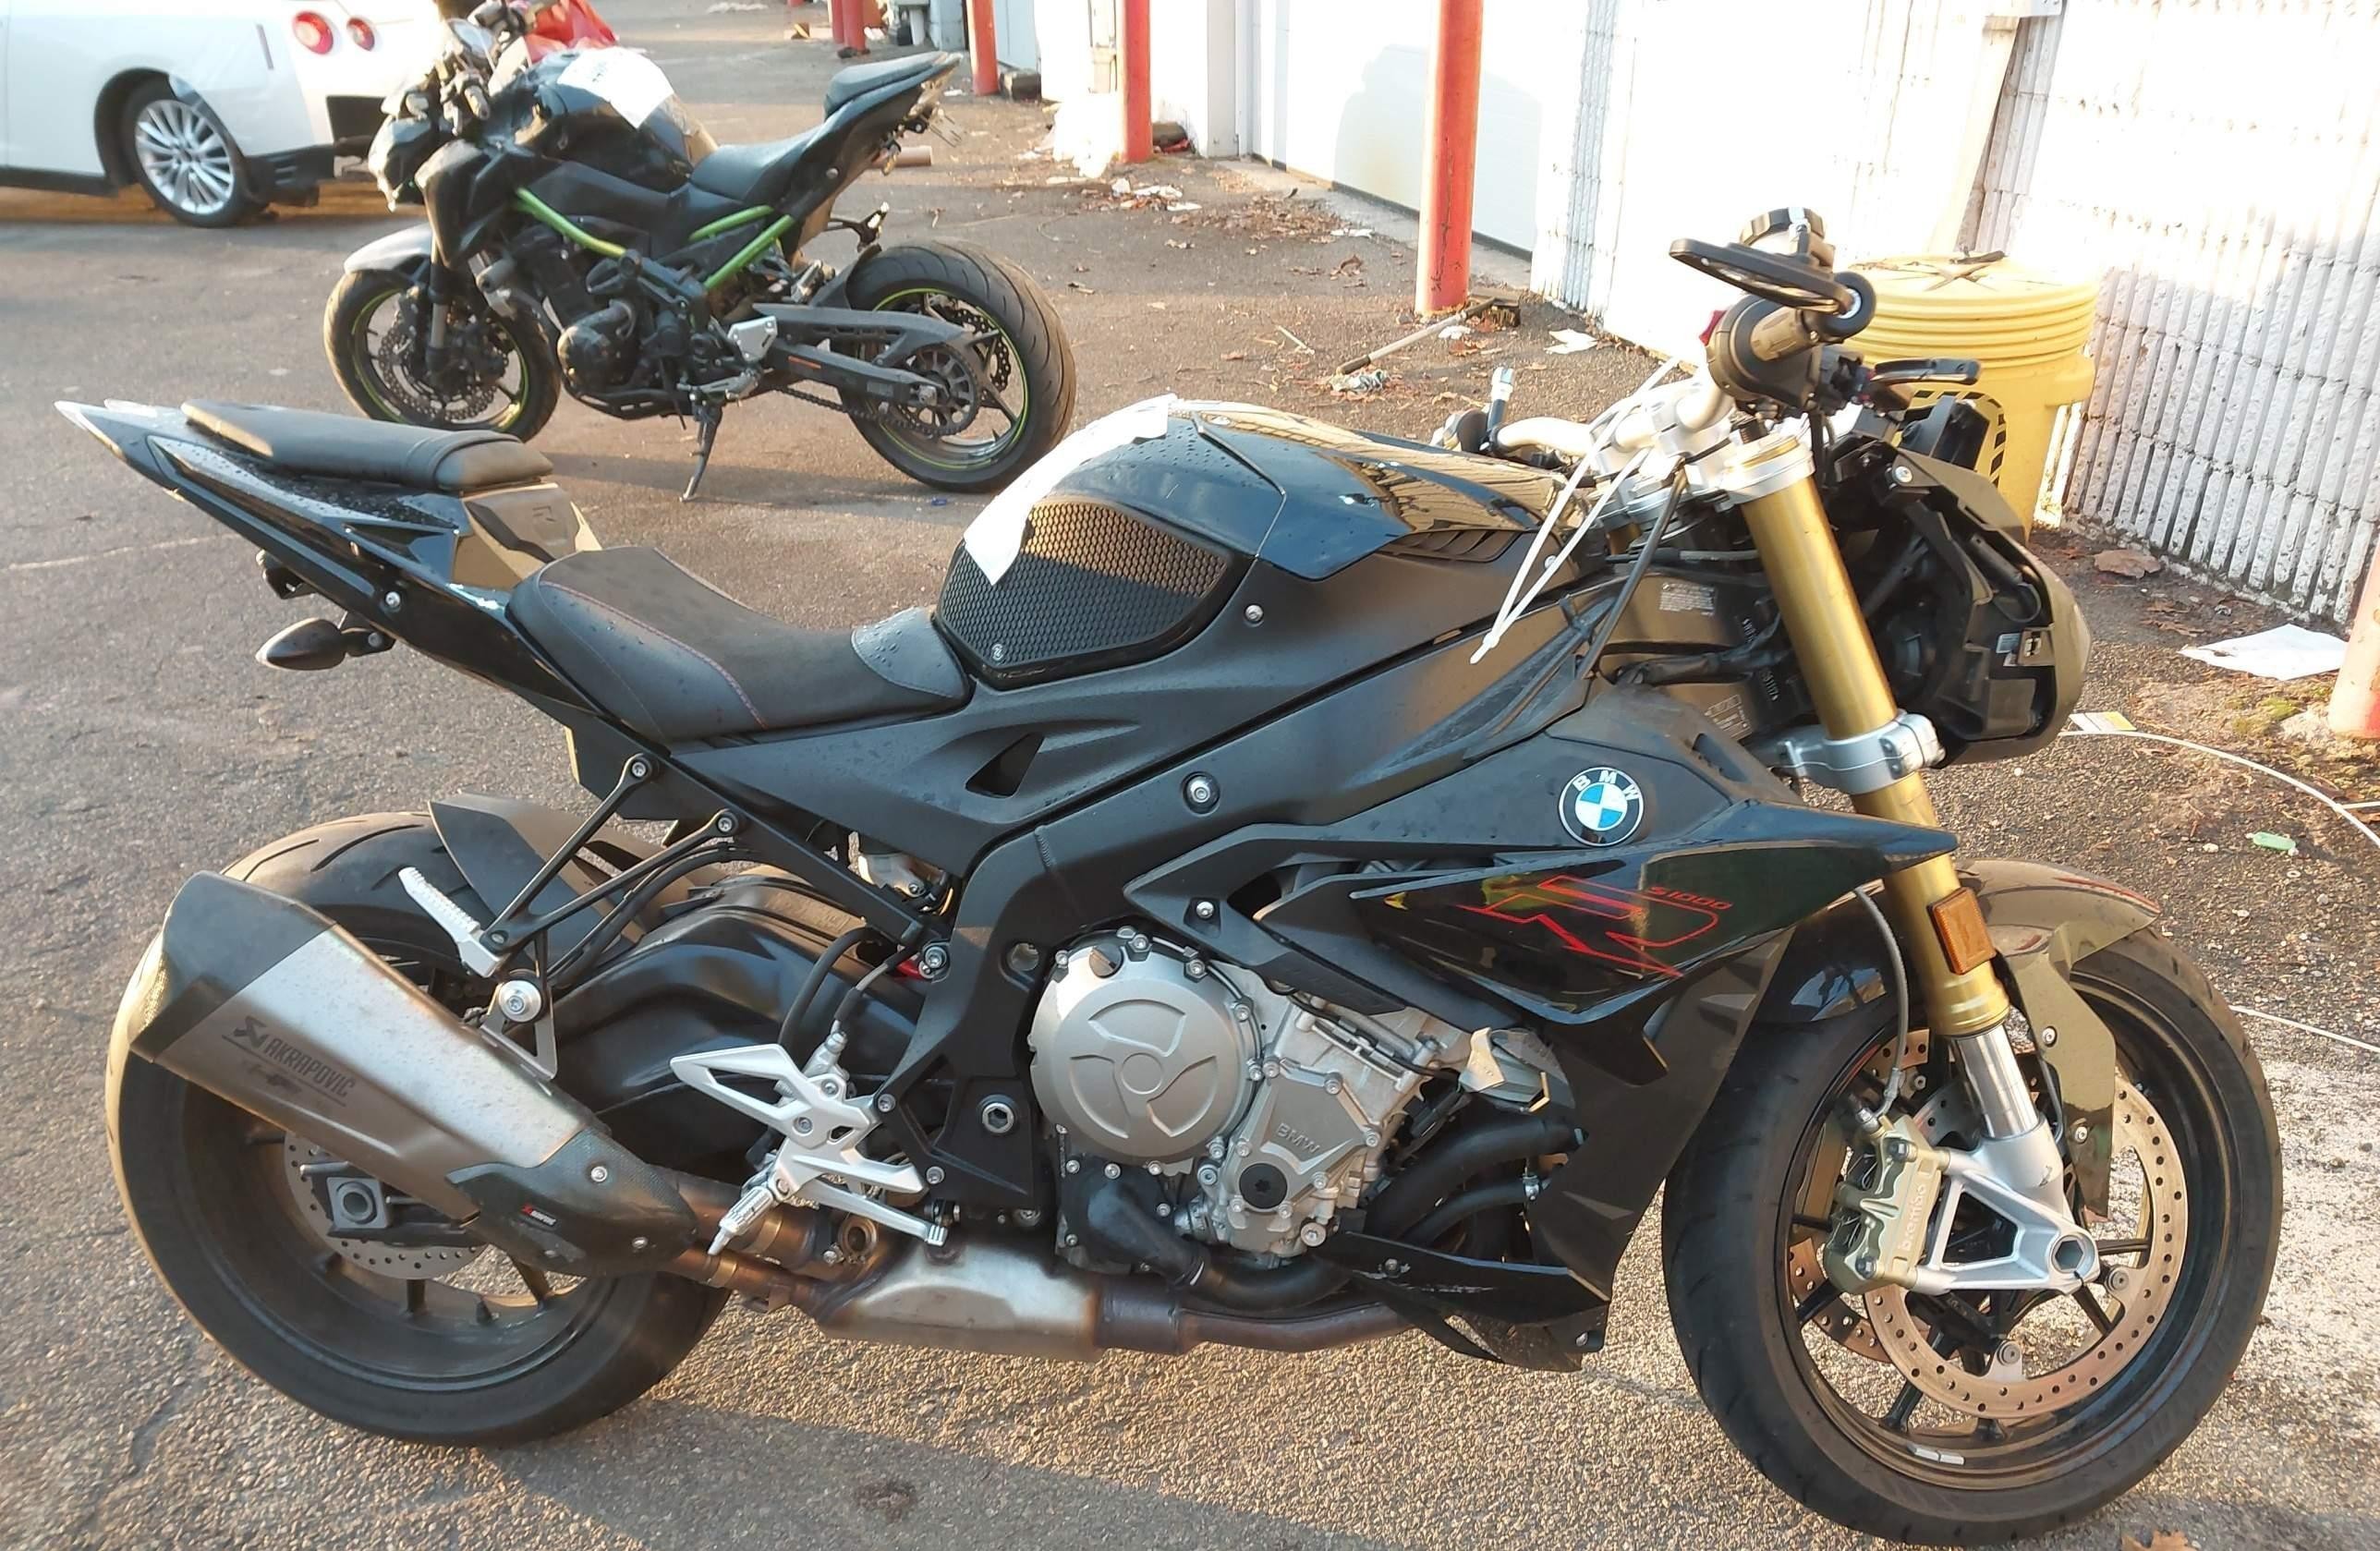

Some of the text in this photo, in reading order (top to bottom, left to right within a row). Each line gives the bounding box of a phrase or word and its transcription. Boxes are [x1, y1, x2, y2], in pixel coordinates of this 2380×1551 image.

[1572, 769, 1640, 801] BMW
[1647, 886, 1732, 910] S1000
[1277, 1122, 1320, 1153] BMW
[1897, 1183, 1927, 1253] brembo
